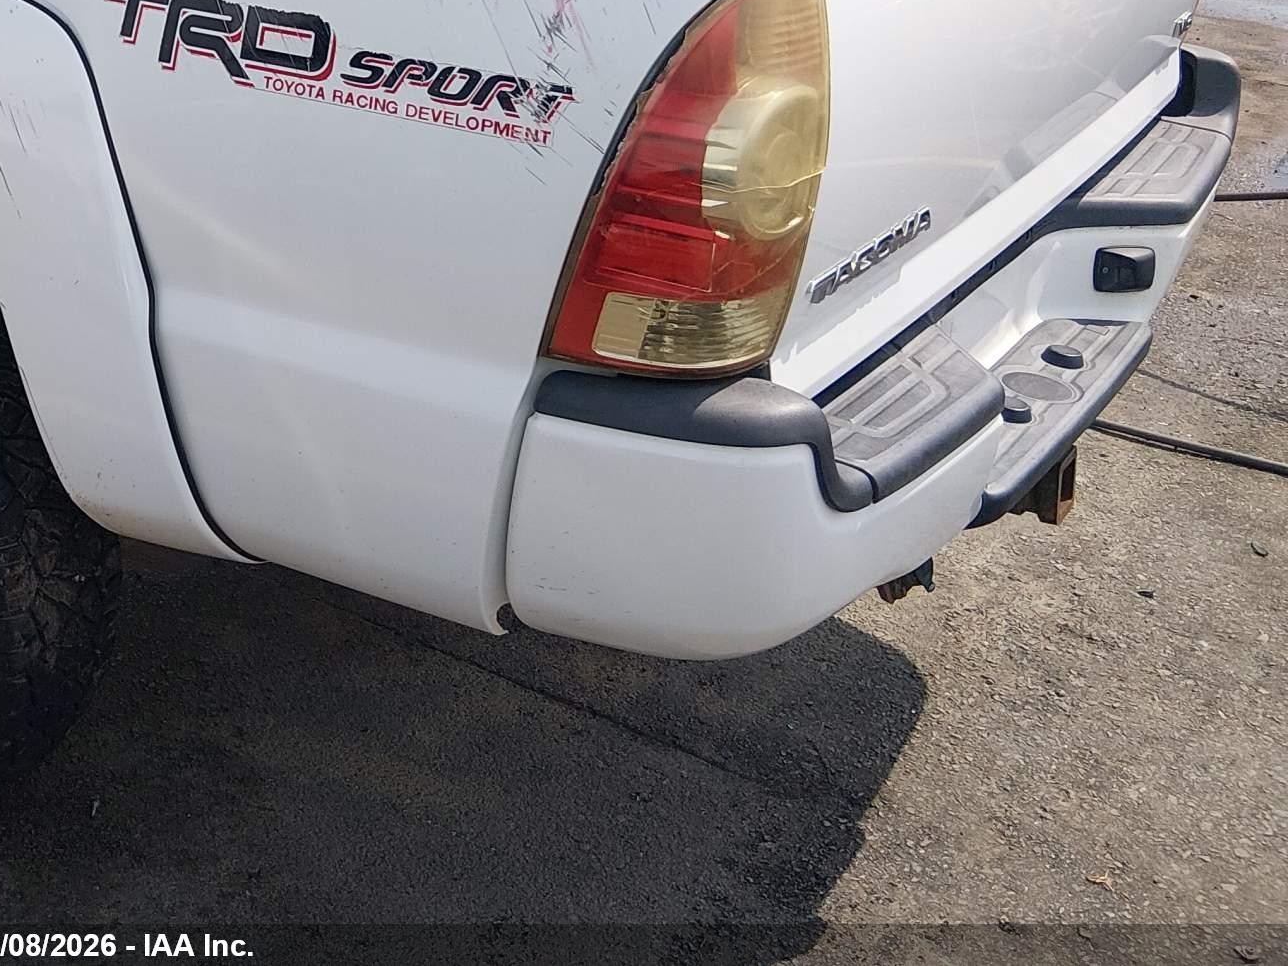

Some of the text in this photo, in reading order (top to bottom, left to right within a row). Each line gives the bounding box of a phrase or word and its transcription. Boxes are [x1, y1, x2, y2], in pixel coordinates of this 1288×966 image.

[263, 75, 551, 145] TOYOTA RACING DEVELOPMENT
[339, 50, 577, 123] SPORT
[807, 206, 930, 303] TACOMA
